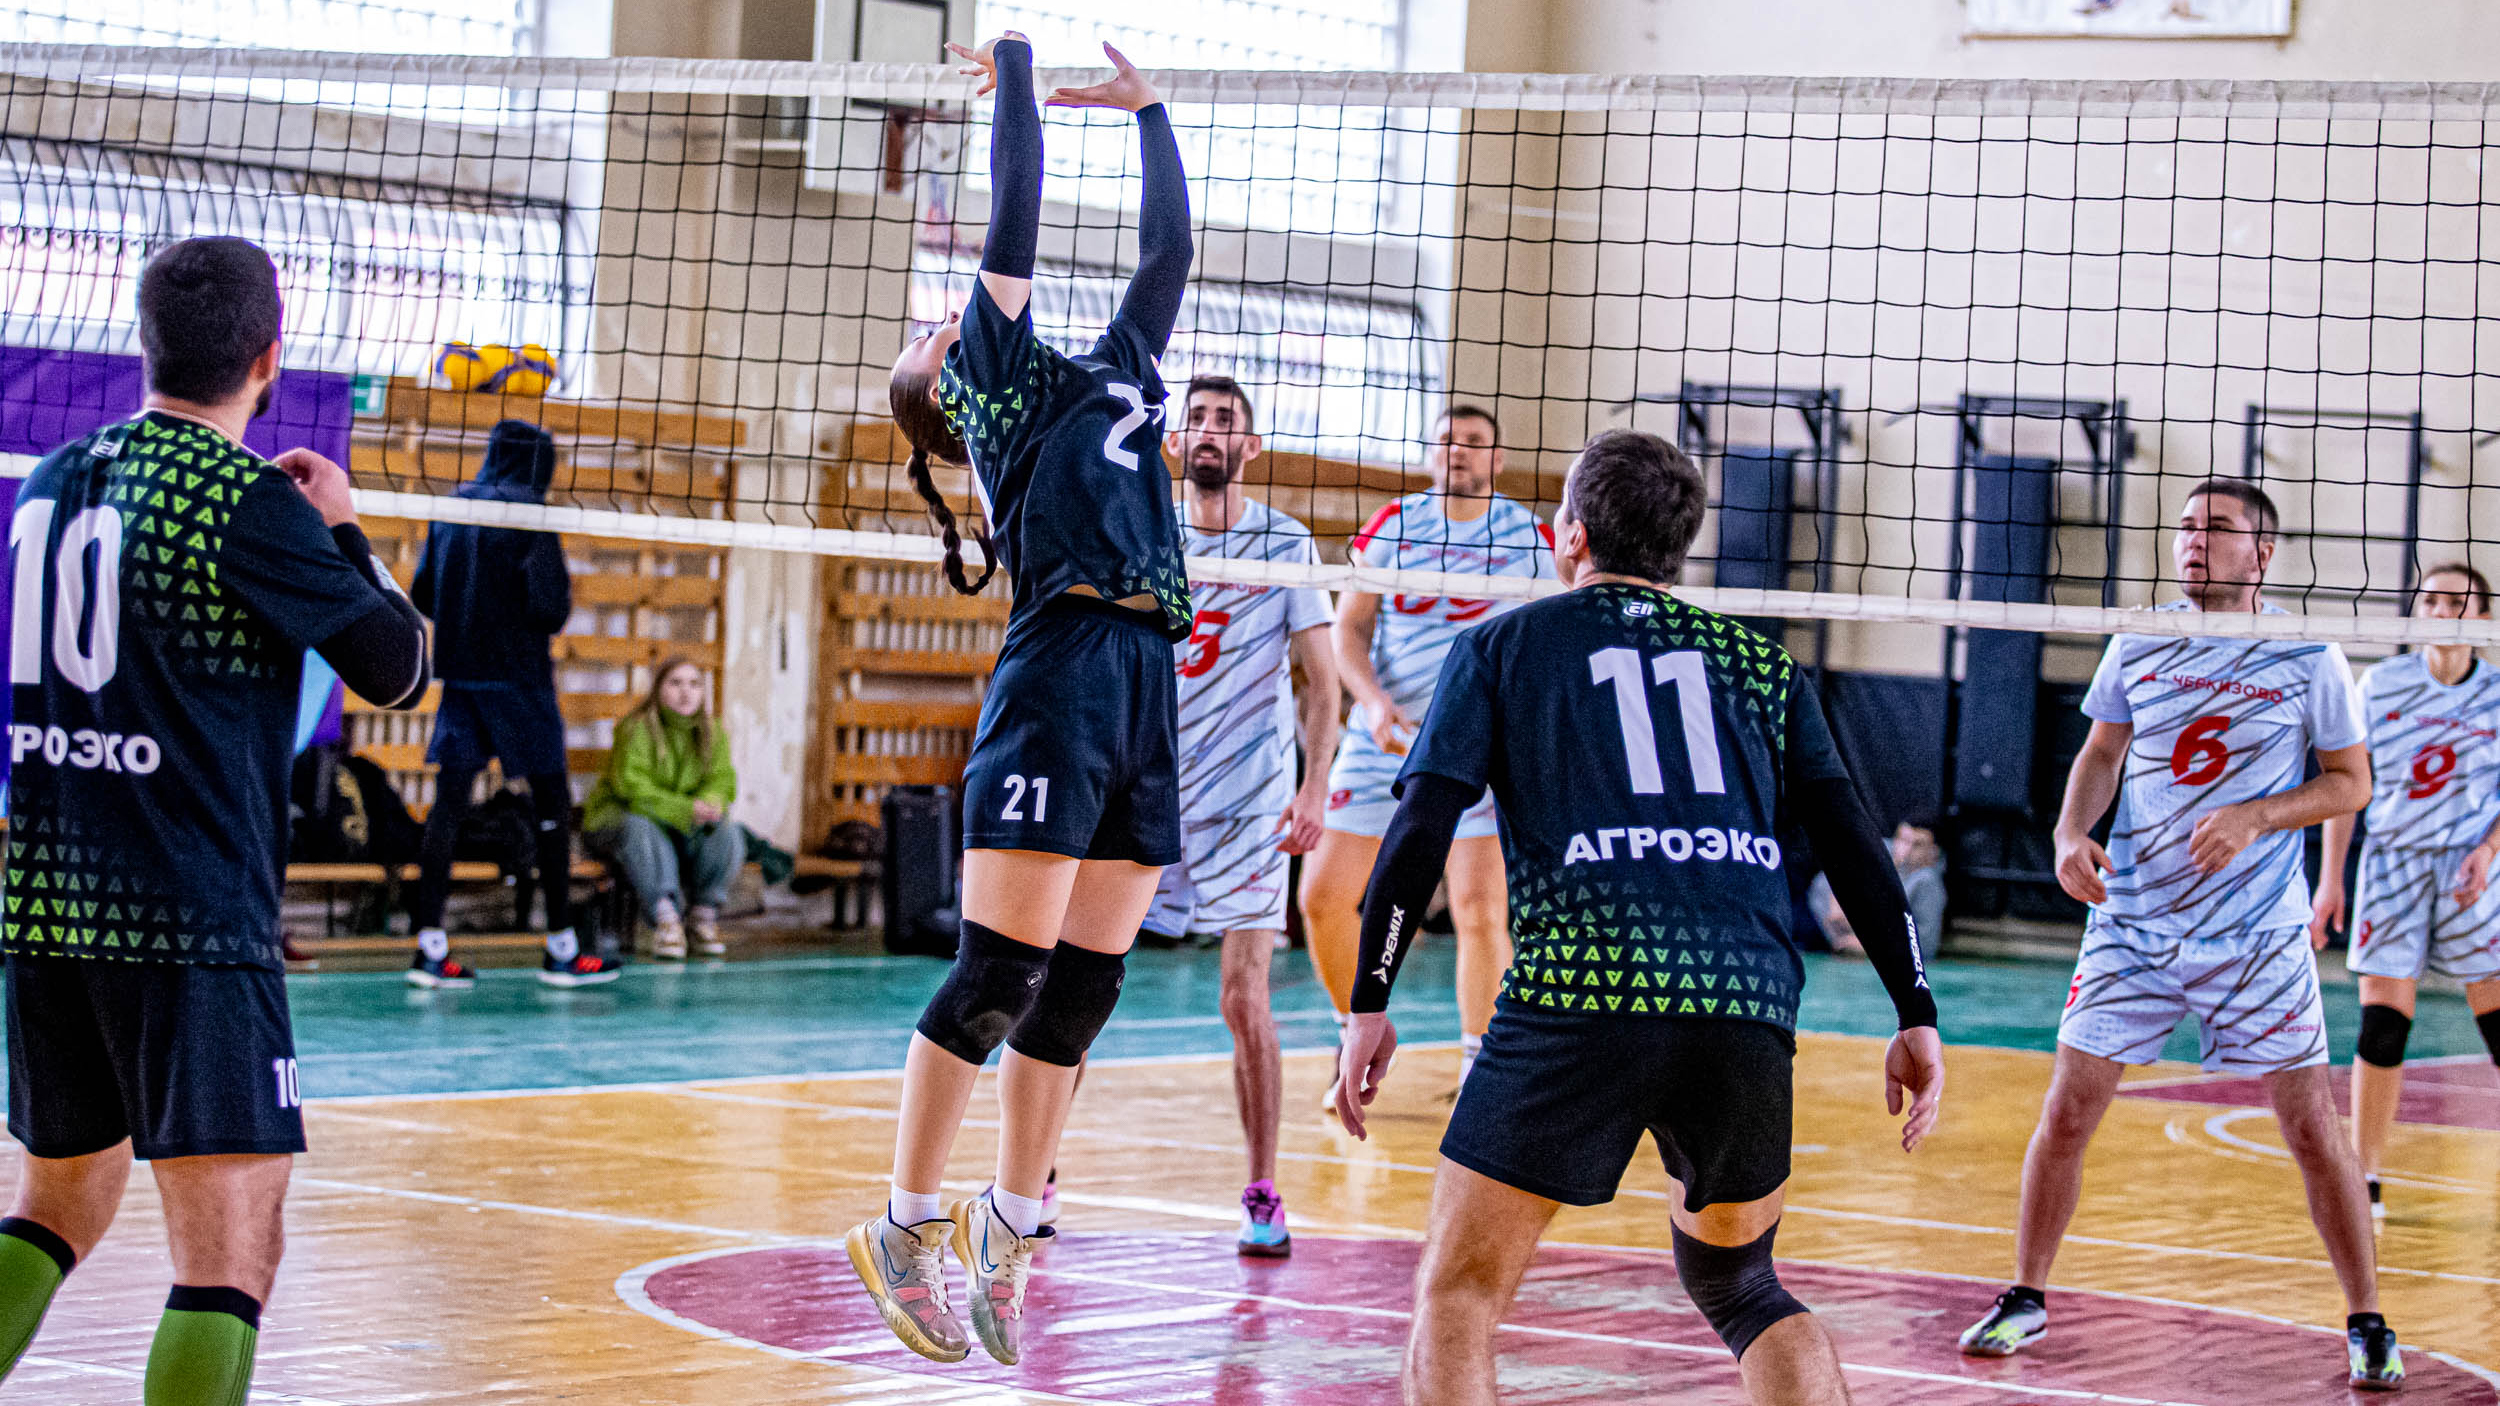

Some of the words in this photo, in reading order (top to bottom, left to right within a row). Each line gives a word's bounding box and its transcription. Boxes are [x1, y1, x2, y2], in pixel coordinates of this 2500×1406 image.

[1103, 382, 1165, 471] 2
[10, 499, 123, 693] 10
[2172, 673, 2283, 705] ЧЕРКИЗОВО
[1588, 647, 1726, 794] 11
[7, 725, 161, 774] РОЭКО
[2168, 715, 2232, 787] 6
[2408, 744, 2457, 799] 9
[1001, 774, 1049, 822] 21
[1564, 827, 1781, 870] АГРОЭКО
[1381, 904, 1405, 967] DEMIX
[272, 1058, 301, 1108] 10
